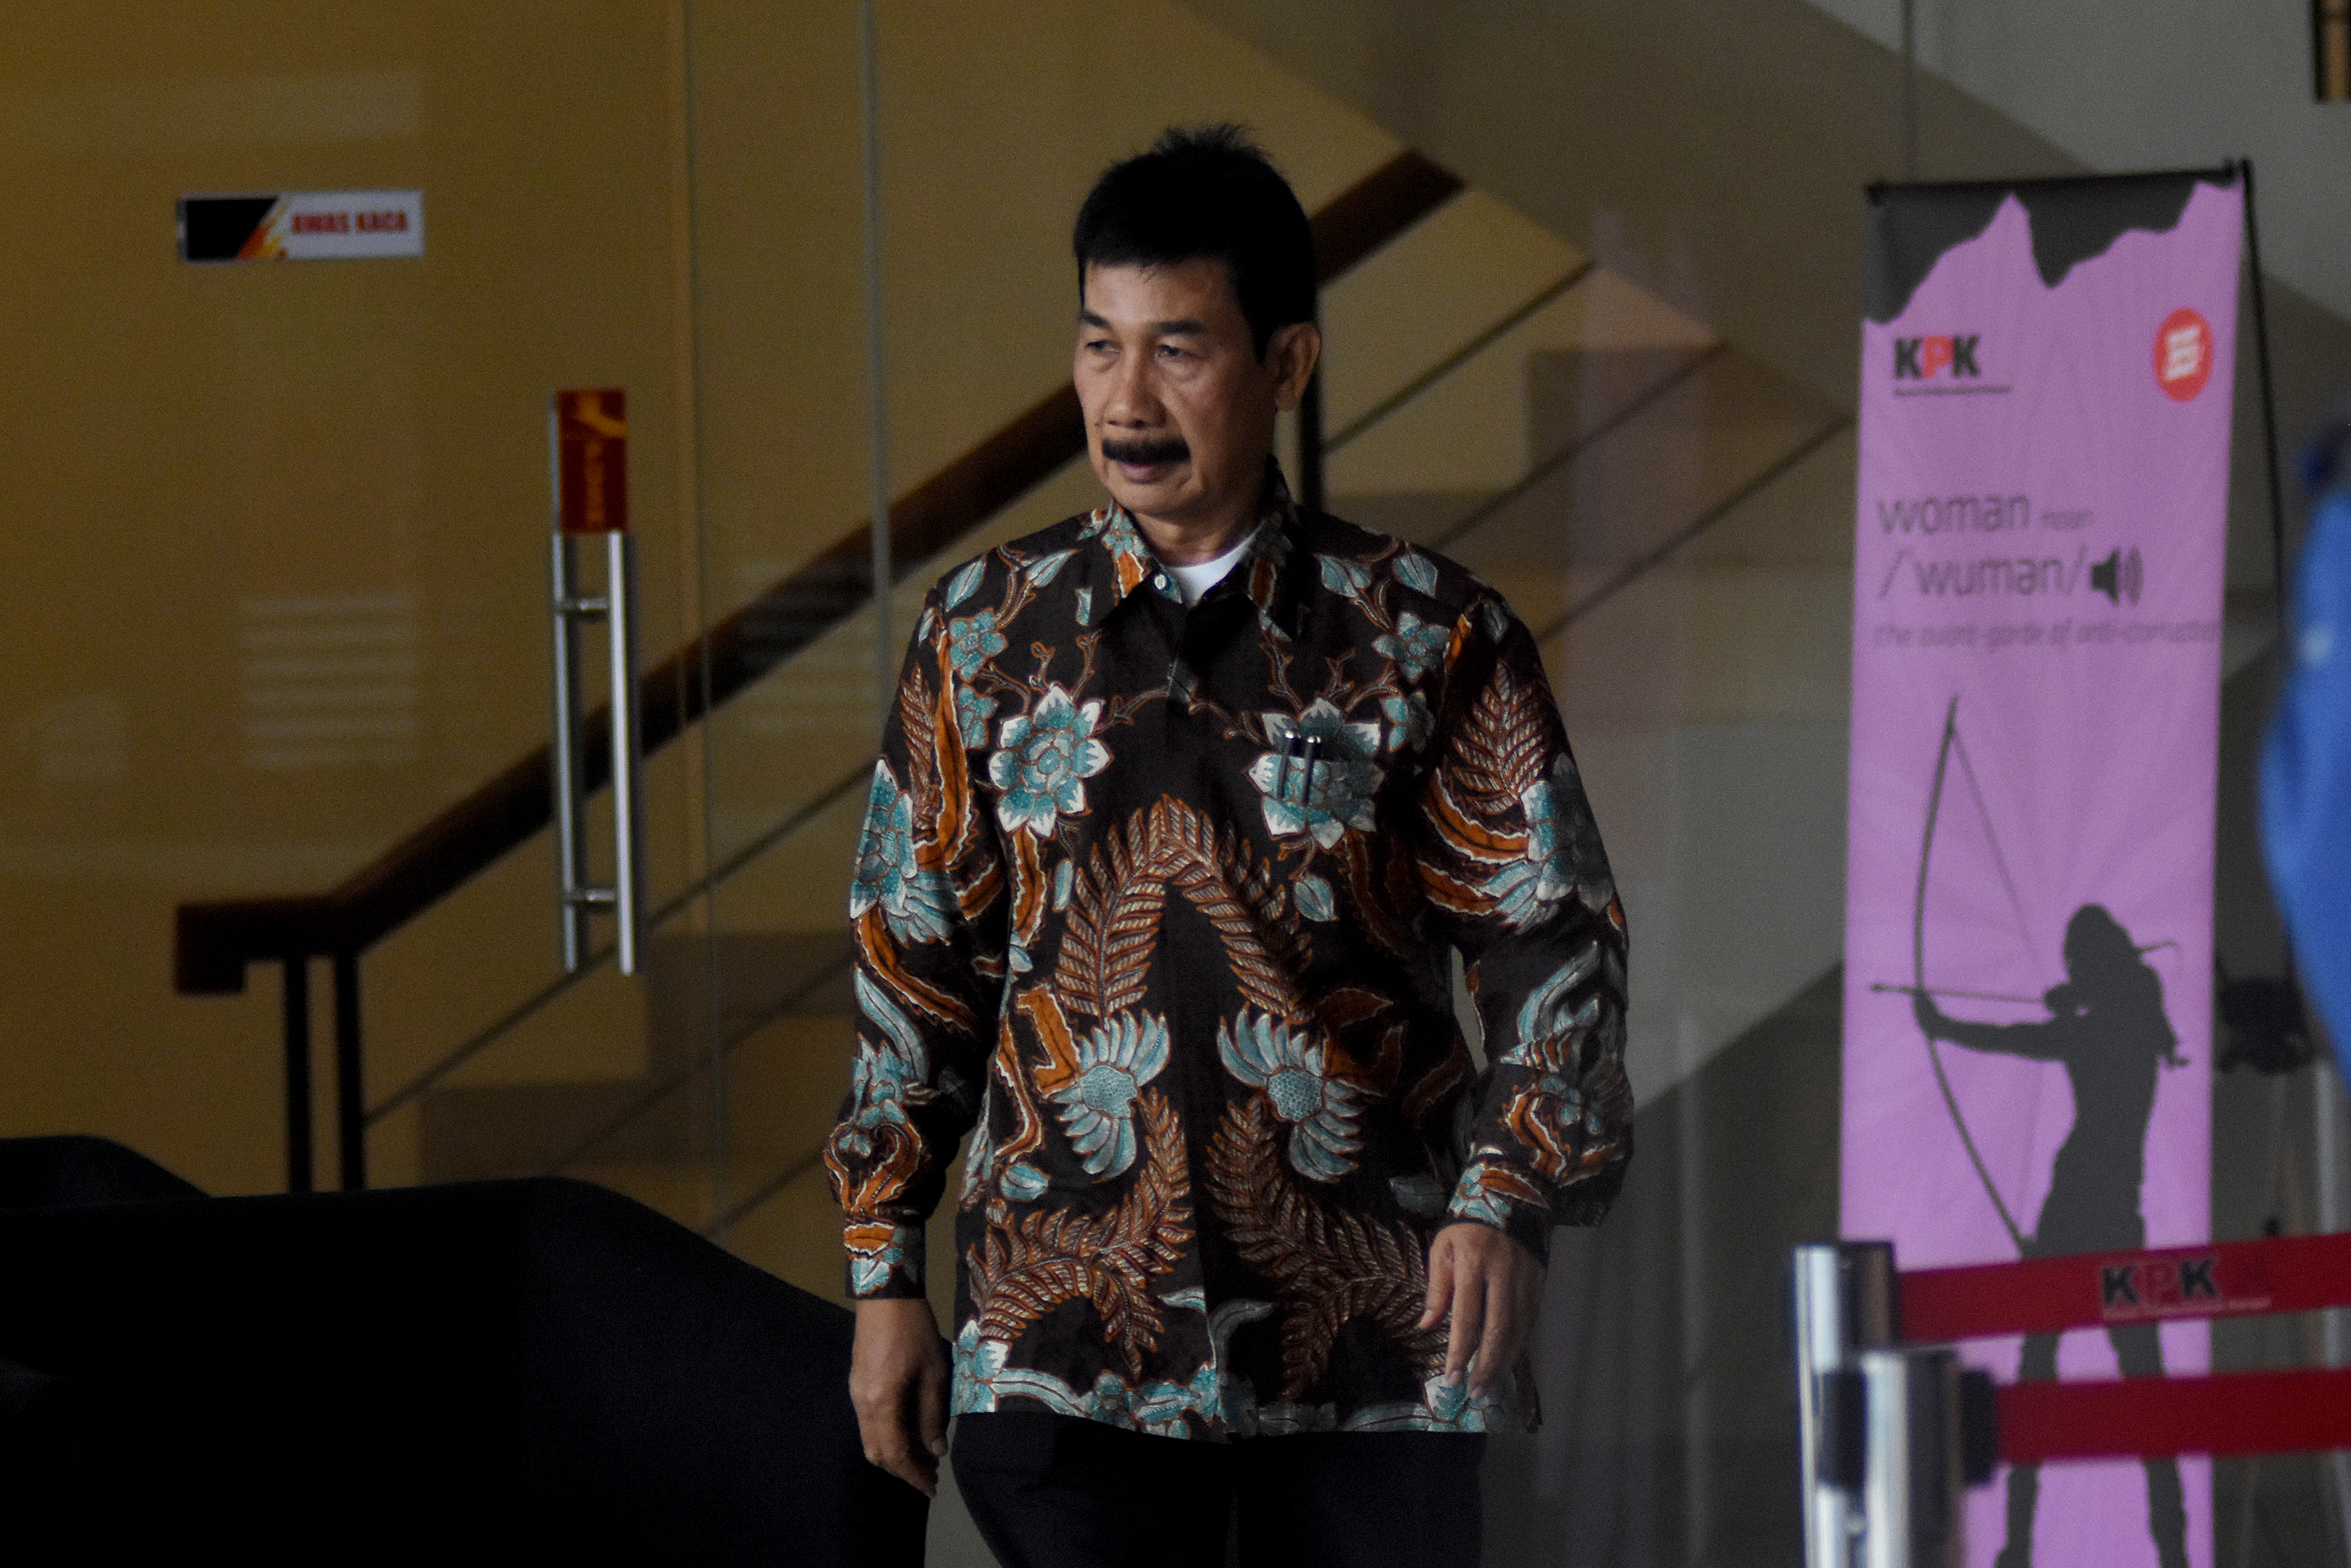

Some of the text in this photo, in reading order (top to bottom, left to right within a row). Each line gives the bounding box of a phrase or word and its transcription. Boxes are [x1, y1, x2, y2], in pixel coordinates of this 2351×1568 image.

[1894, 335, 1981, 380] KPK
[1880, 494, 2030, 534] woman
[2102, 1258, 2219, 1306] KPK
